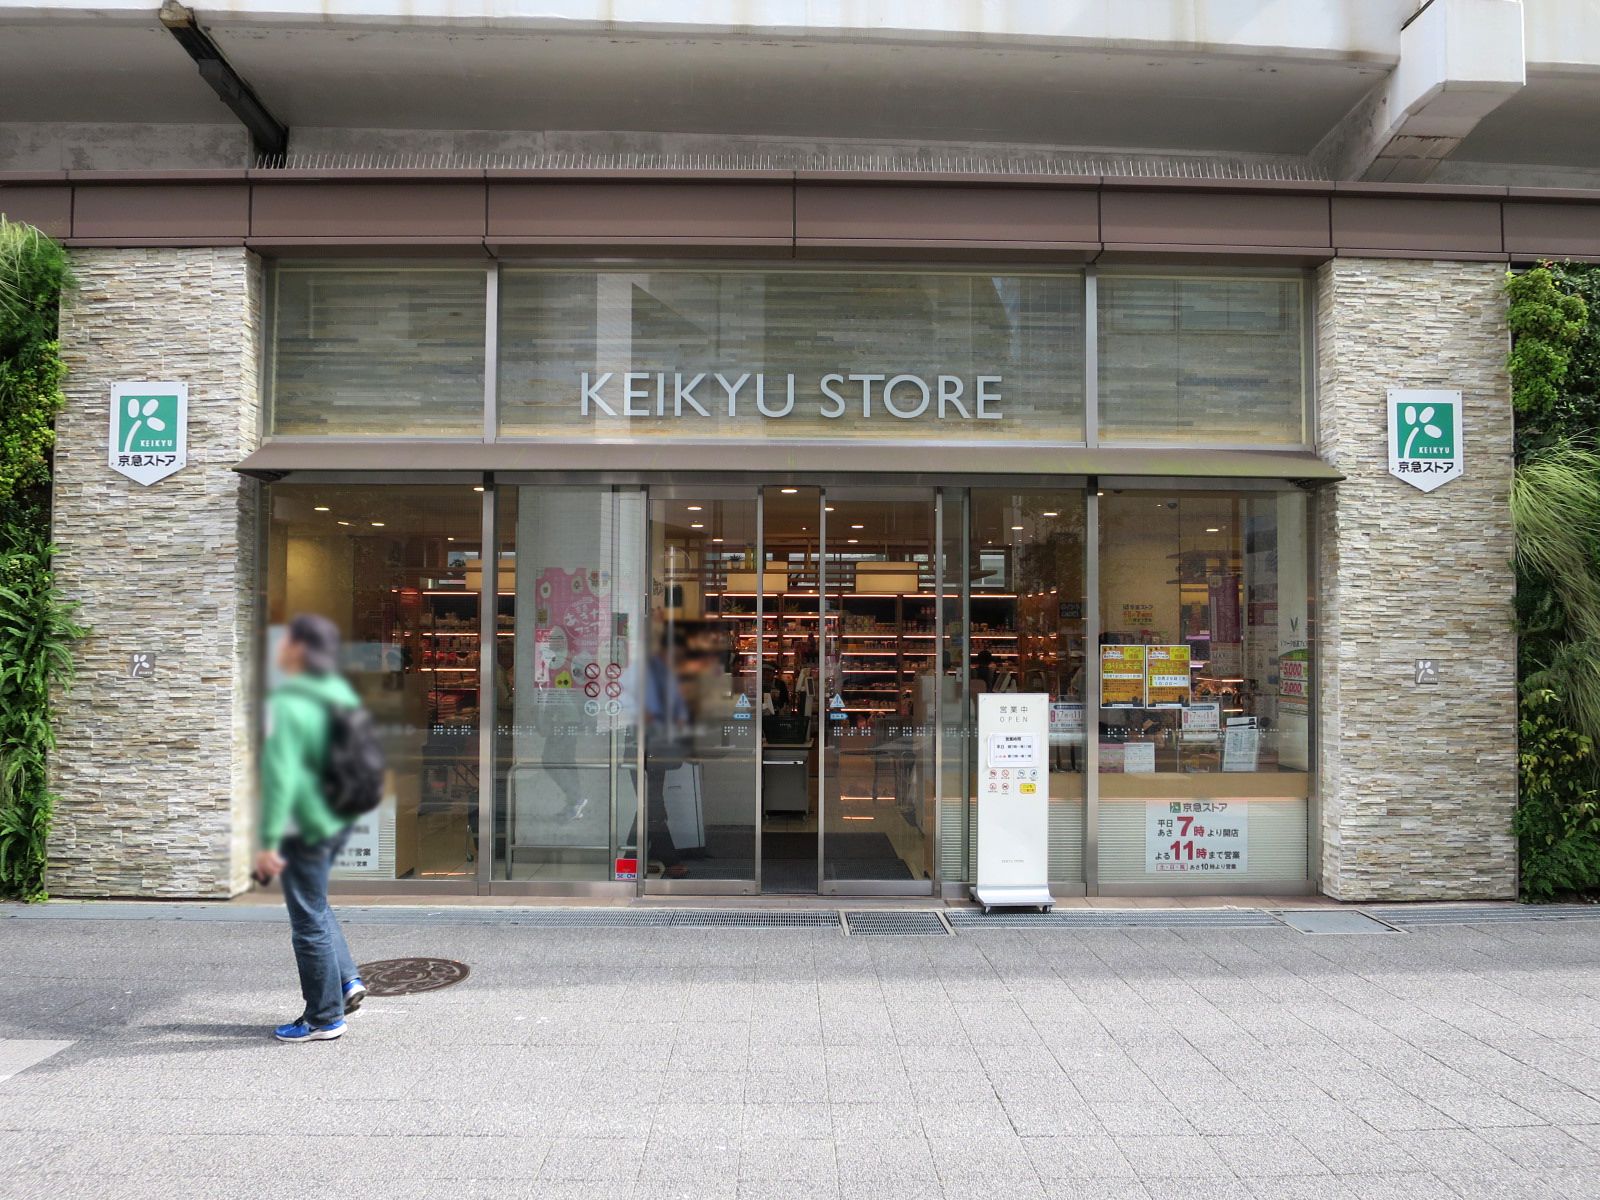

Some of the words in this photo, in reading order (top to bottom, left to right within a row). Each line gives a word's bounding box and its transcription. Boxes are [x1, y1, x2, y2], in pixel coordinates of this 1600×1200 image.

[580, 372, 796, 418] KEIKYU
[820, 374, 1003, 420] STORE
[1418, 446, 1450, 454] KEIKYU
[118, 455, 177, 467] 京急ストア
[1398, 461, 1455, 473] 京急ストア
[1183, 803, 1227, 813] 京急ストア
[1158, 819, 1173, 828] 平日
[1155, 840, 1240, 860] よる11時まで営業
